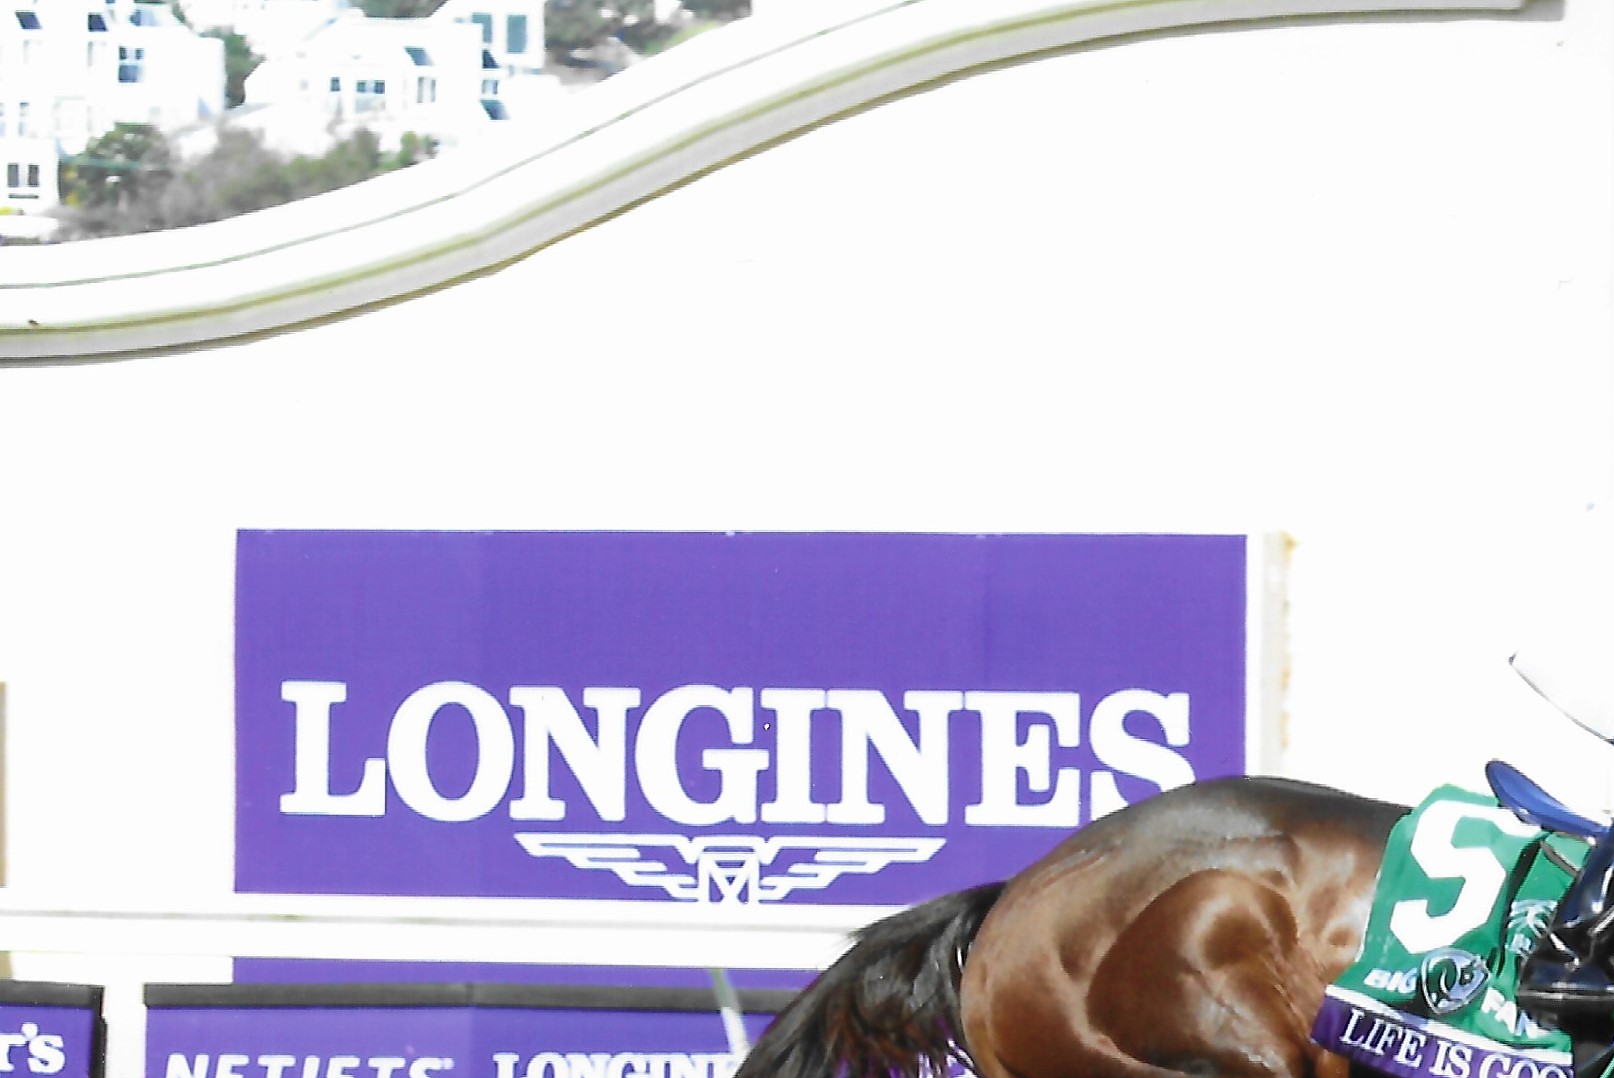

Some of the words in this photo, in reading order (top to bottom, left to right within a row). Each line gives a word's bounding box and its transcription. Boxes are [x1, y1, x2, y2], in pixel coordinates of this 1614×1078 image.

[279, 680, 1195, 828] LONGINES
[1341, 1007, 1427, 1068] LIFE
[1481, 986, 1556, 1039] FAN
